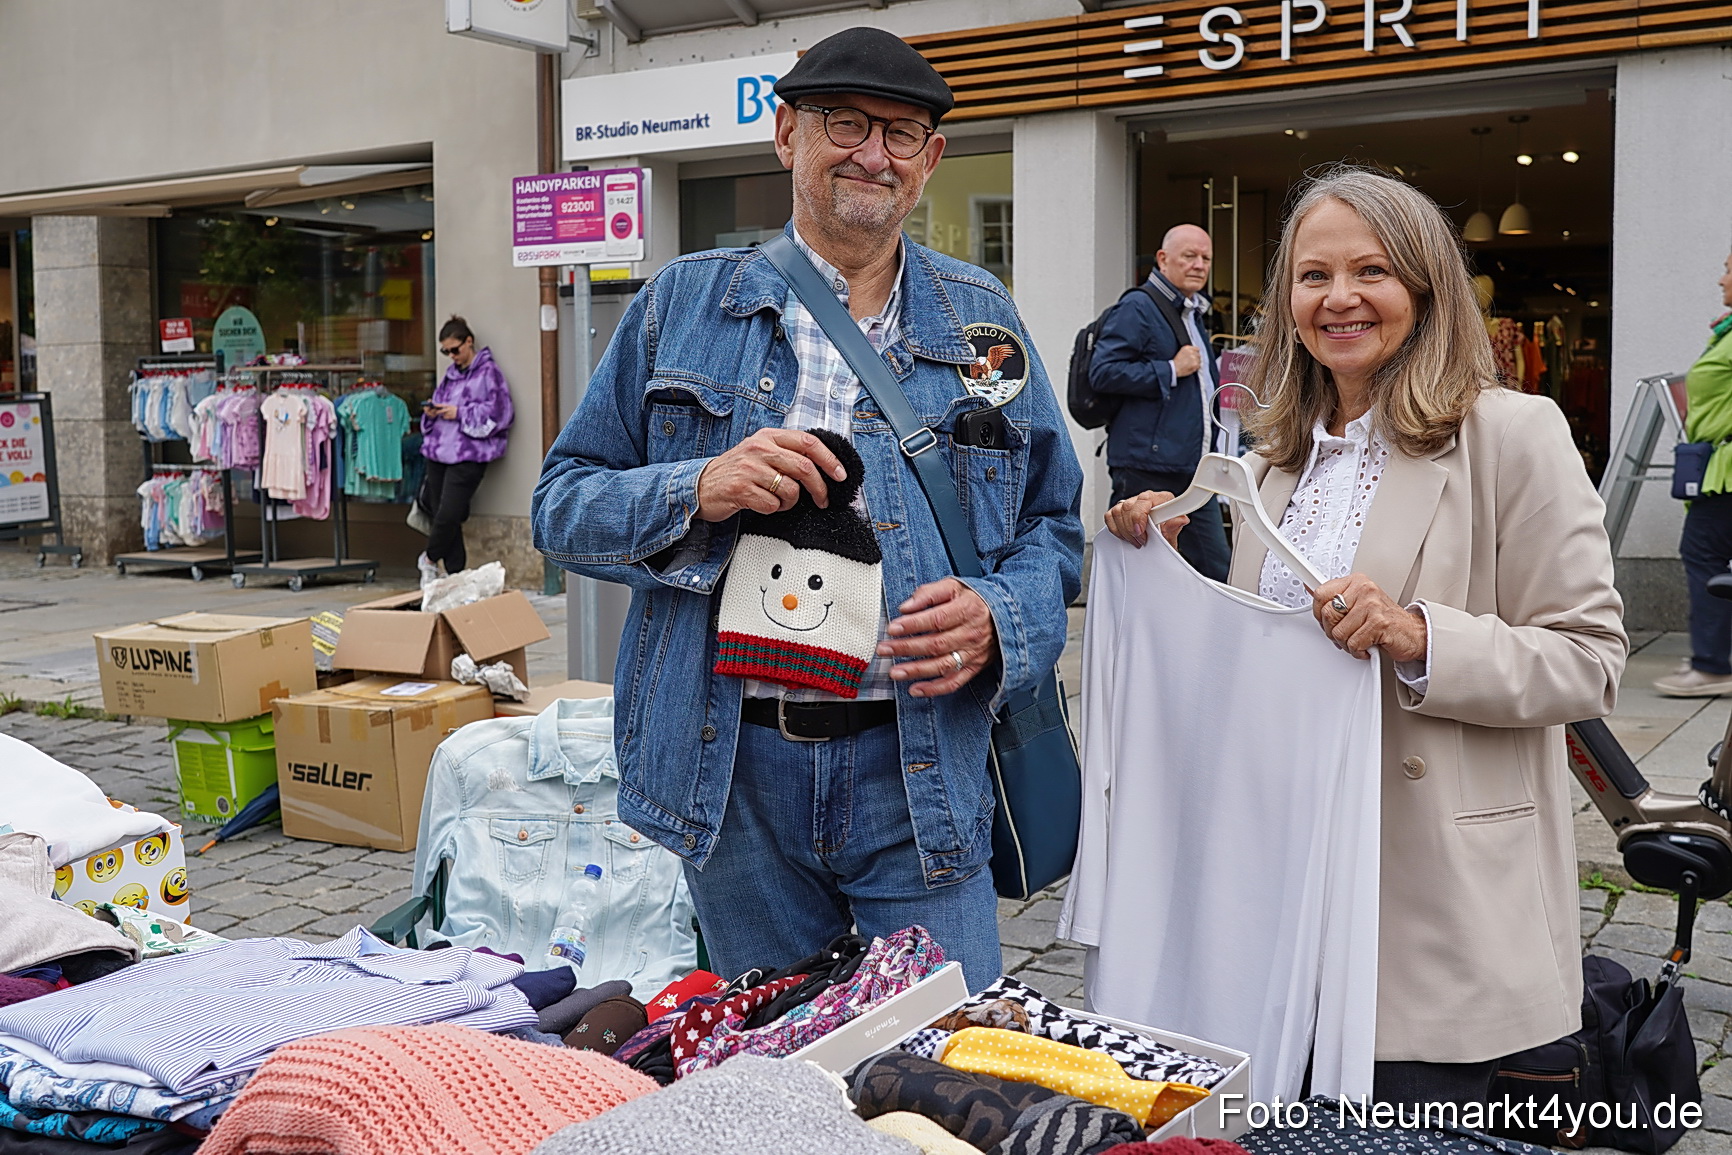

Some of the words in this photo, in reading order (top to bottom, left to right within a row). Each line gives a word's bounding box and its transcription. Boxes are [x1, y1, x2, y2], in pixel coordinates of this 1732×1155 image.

[575, 119, 639, 141] BR-Studio
[641, 113, 711, 134] Neumarkt
[516, 175, 601, 194] HANDYPARKEN
[561, 200, 595, 213] 923001
[11, 437, 27, 448] DIE
[7, 449, 33, 461] VOLL!
[130, 647, 197, 673] LUPINE
[864, 1015, 900, 1039] Tamaris
